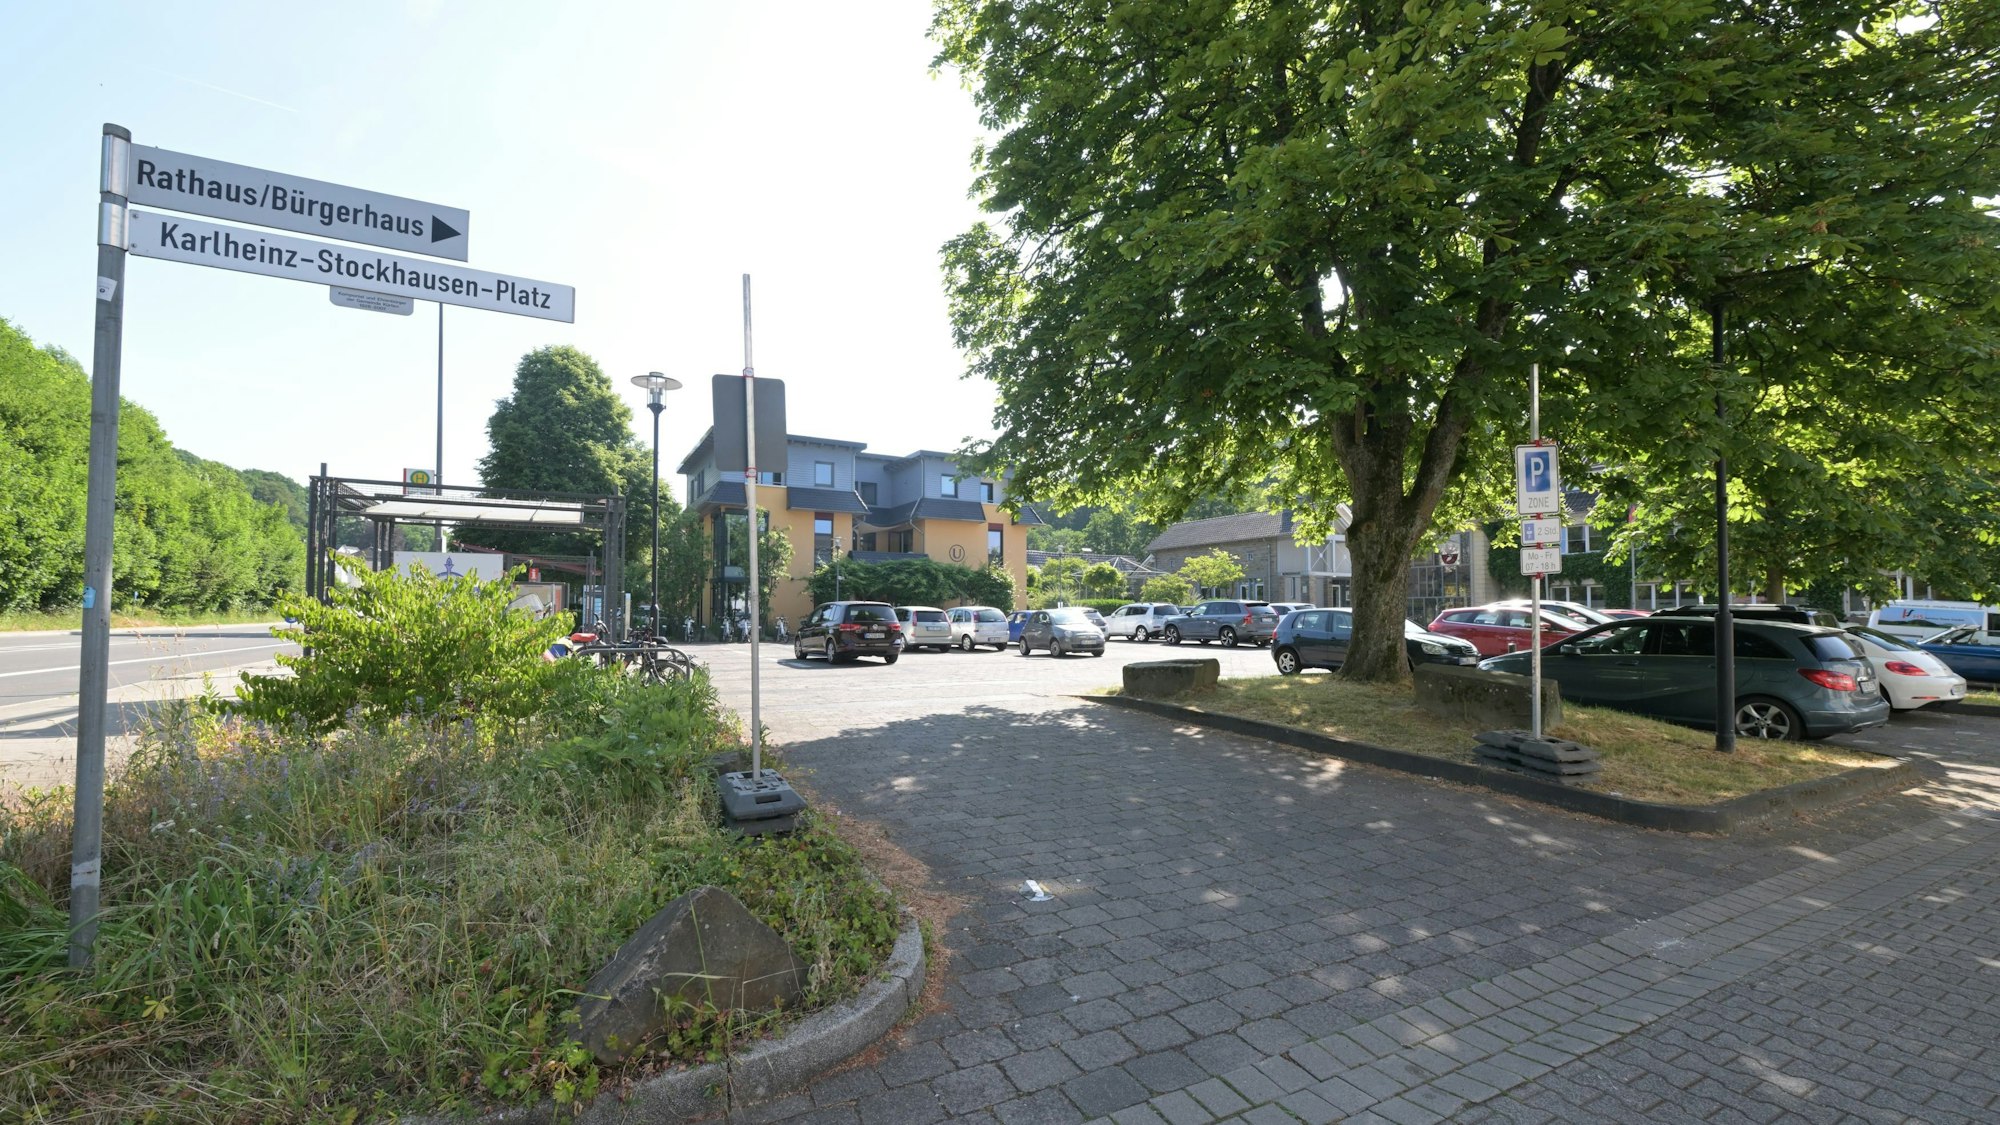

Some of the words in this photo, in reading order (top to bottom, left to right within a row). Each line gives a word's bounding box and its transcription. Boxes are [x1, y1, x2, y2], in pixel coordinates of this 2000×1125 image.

[137, 159, 424, 237] Rathaus/Bürgerhaus
[160, 221, 552, 310] Karlheinz-Stockhausen-Platz
[1530, 457, 1545, 487] P
[416, 474, 425, 485] H
[1528, 497, 1549, 509] ZONE
[1537, 527, 1543, 536] 2
[1544, 526, 1559, 536] Std.
[1528, 552, 1539, 560] Mo
[1545, 551, 1553, 560] Fr
[1525, 562, 1534, 571] 07
[1541, 561, 1549, 570] 18
